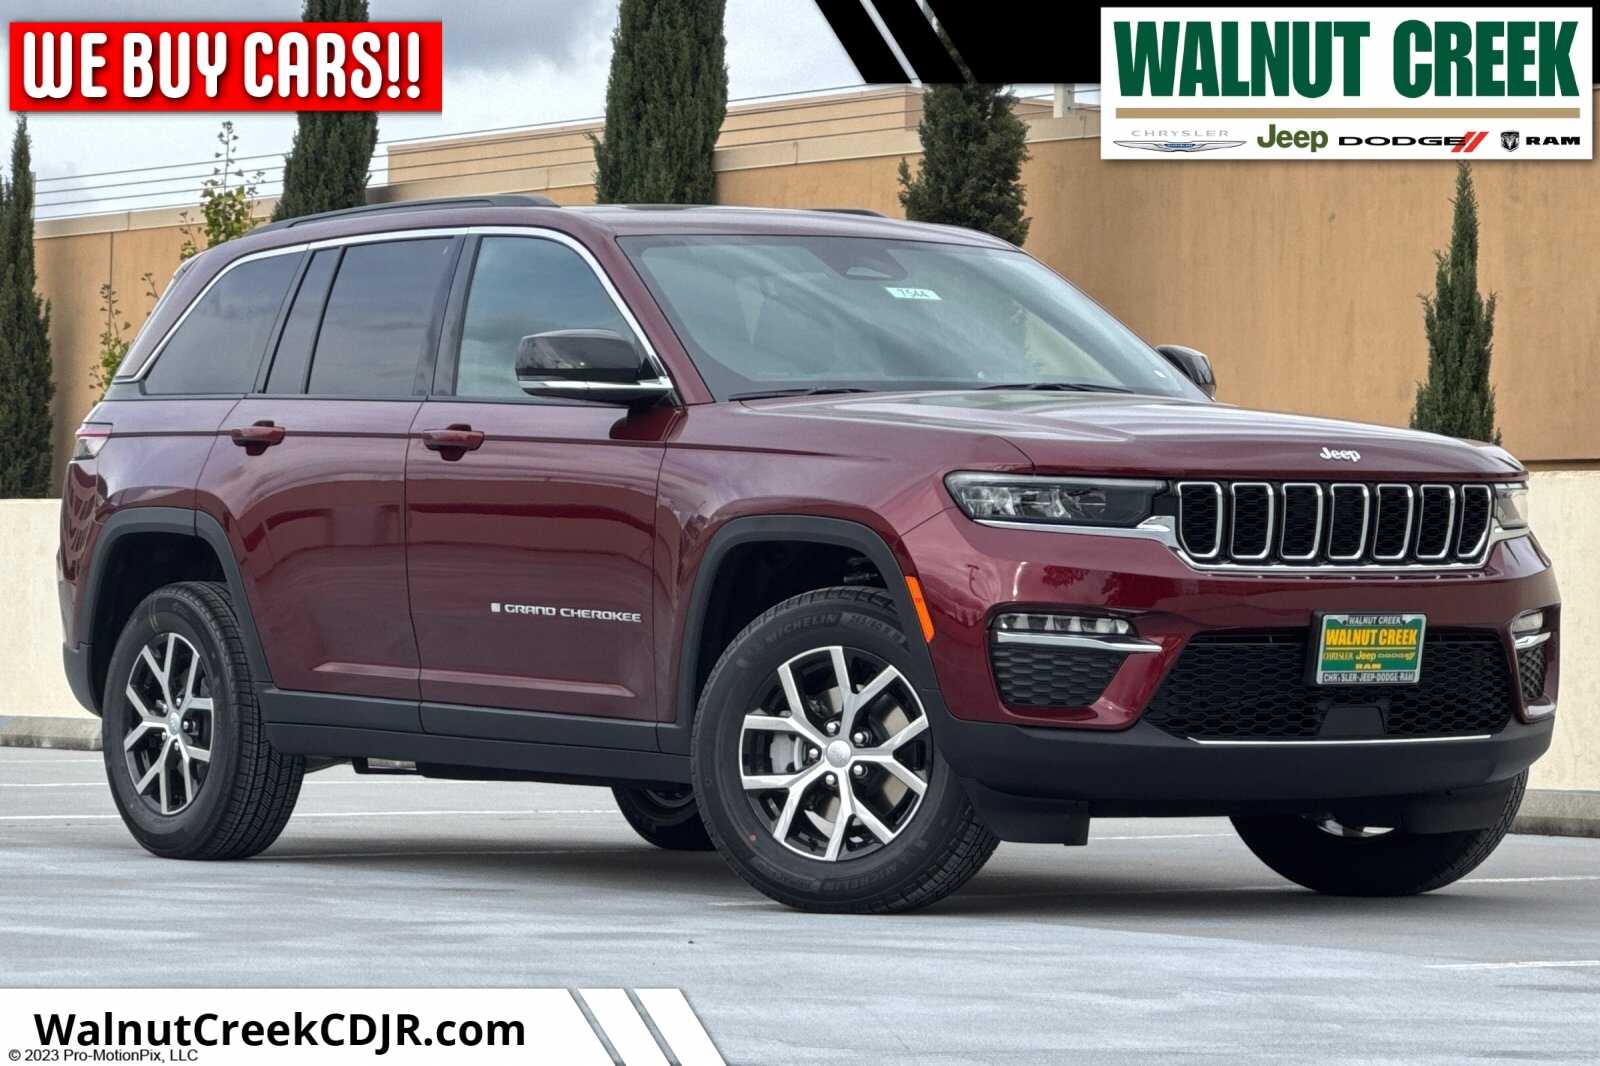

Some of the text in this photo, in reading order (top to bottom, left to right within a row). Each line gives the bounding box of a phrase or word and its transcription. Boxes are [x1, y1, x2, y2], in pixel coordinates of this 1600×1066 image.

[1319, 446, 1361, 462] Jeep
[504, 604, 642, 622] GRAND CHEROKEE
[1349, 616, 1402, 625] WALNUT CREEK
[765, 613, 837, 643] MICHELIN
[1326, 628, 1418, 646] WALNUT CREEK
[1356, 650, 1377, 662] Jeep
